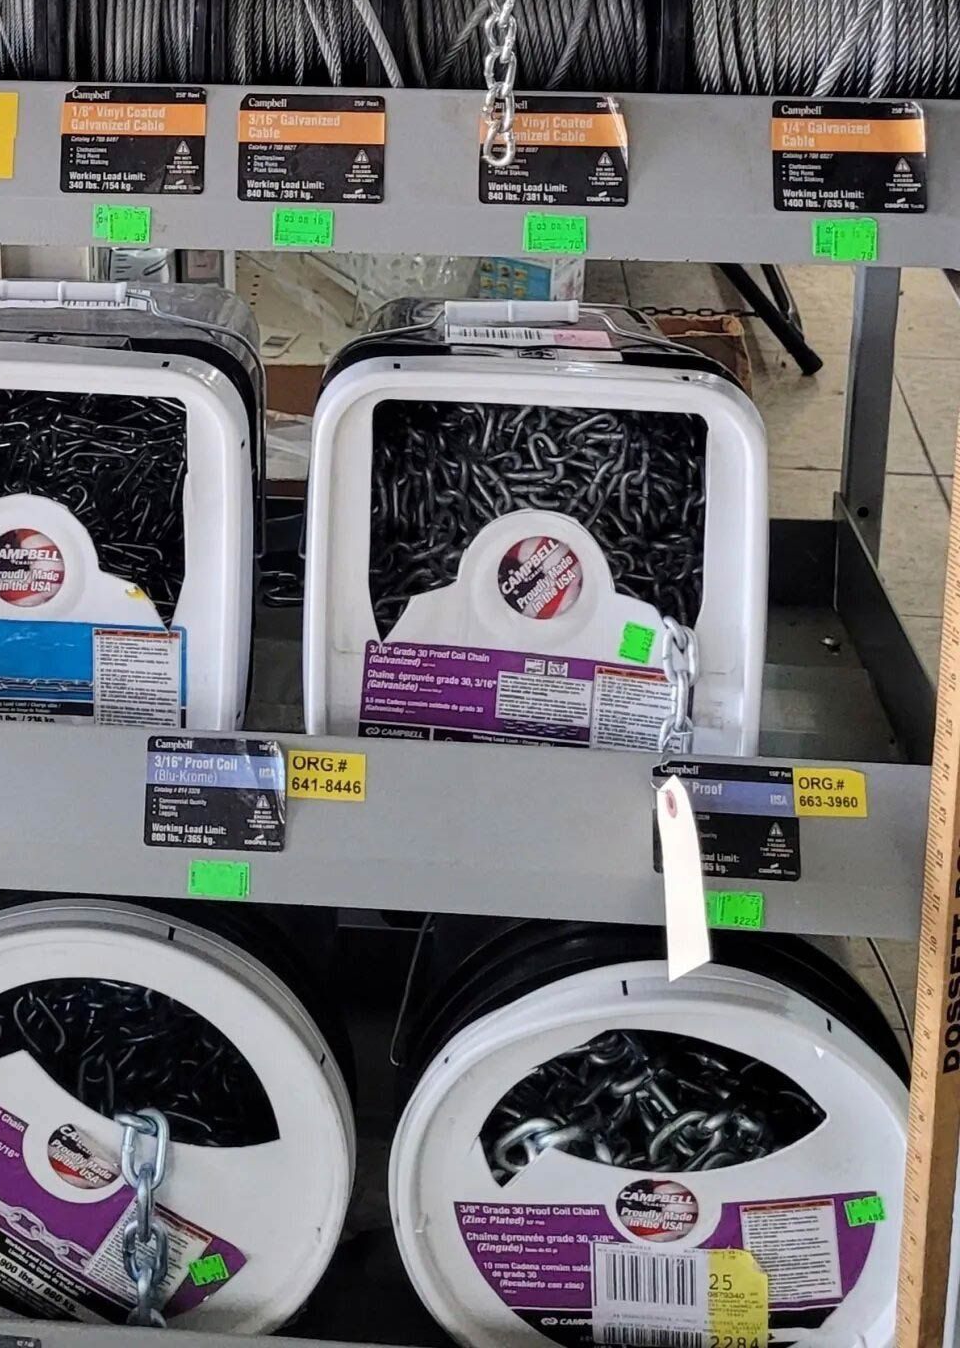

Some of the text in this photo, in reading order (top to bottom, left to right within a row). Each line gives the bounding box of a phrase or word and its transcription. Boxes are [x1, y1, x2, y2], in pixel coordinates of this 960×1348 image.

[72, 91, 110, 101] Campbell
[249, 98, 287, 109] Campbell
[97, 107, 124, 120] Vinyl
[127, 107, 165, 118] Coated
[782, 105, 822, 115] Campbell
[71, 119, 164, 131] Galvanized Cable
[281, 115, 340, 126] Galvanized
[249, 127, 280, 138] Cable
[808, 123, 870, 134] Galvanized
[782, 135, 815, 147] Cable
[502, 540, 559, 594] CAMPBELL
[32, 570, 59, 581] Made
[11, 582, 29, 591] the
[30, 582, 51, 591] USA
[517, 556, 573, 609] Proudly Made
[542, 587, 558, 603] the
[555, 569, 575, 590] USA
[369, 655, 421, 667] (Galvanized)
[394, 648, 415, 656] Grade
[451, 651, 465, 660] Coil
[468, 652, 489, 662] Chain
[155, 739, 193, 750] Campbell
[185, 757, 214, 769] Proof
[216, 759, 238, 771] Coil
[292, 756, 348, 772] ORG.#
[154, 770, 217, 783] (Blu-Krome)
[292, 777, 361, 794] 641-8446
[693, 782, 723, 795] Proof
[798, 777, 845, 790] ORG.#
[770, 795, 787, 805] USA
[799, 796, 858, 807] 663-3960
[620, 1192, 693, 1204] CAMPBELL
[483, 1206, 510, 1215] Grade
[512, 1207, 523, 1215] 30
[526, 1207, 550, 1215] Proof
[553, 1207, 570, 1215] Coil
[621, 1207, 692, 1221] Proudly Made
[462, 1215, 524, 1226] (Zinc Plated)
[643, 1220, 659, 1228] the
[662, 1222, 683, 1230] USA
[709, 1273, 732, 1290] 25
